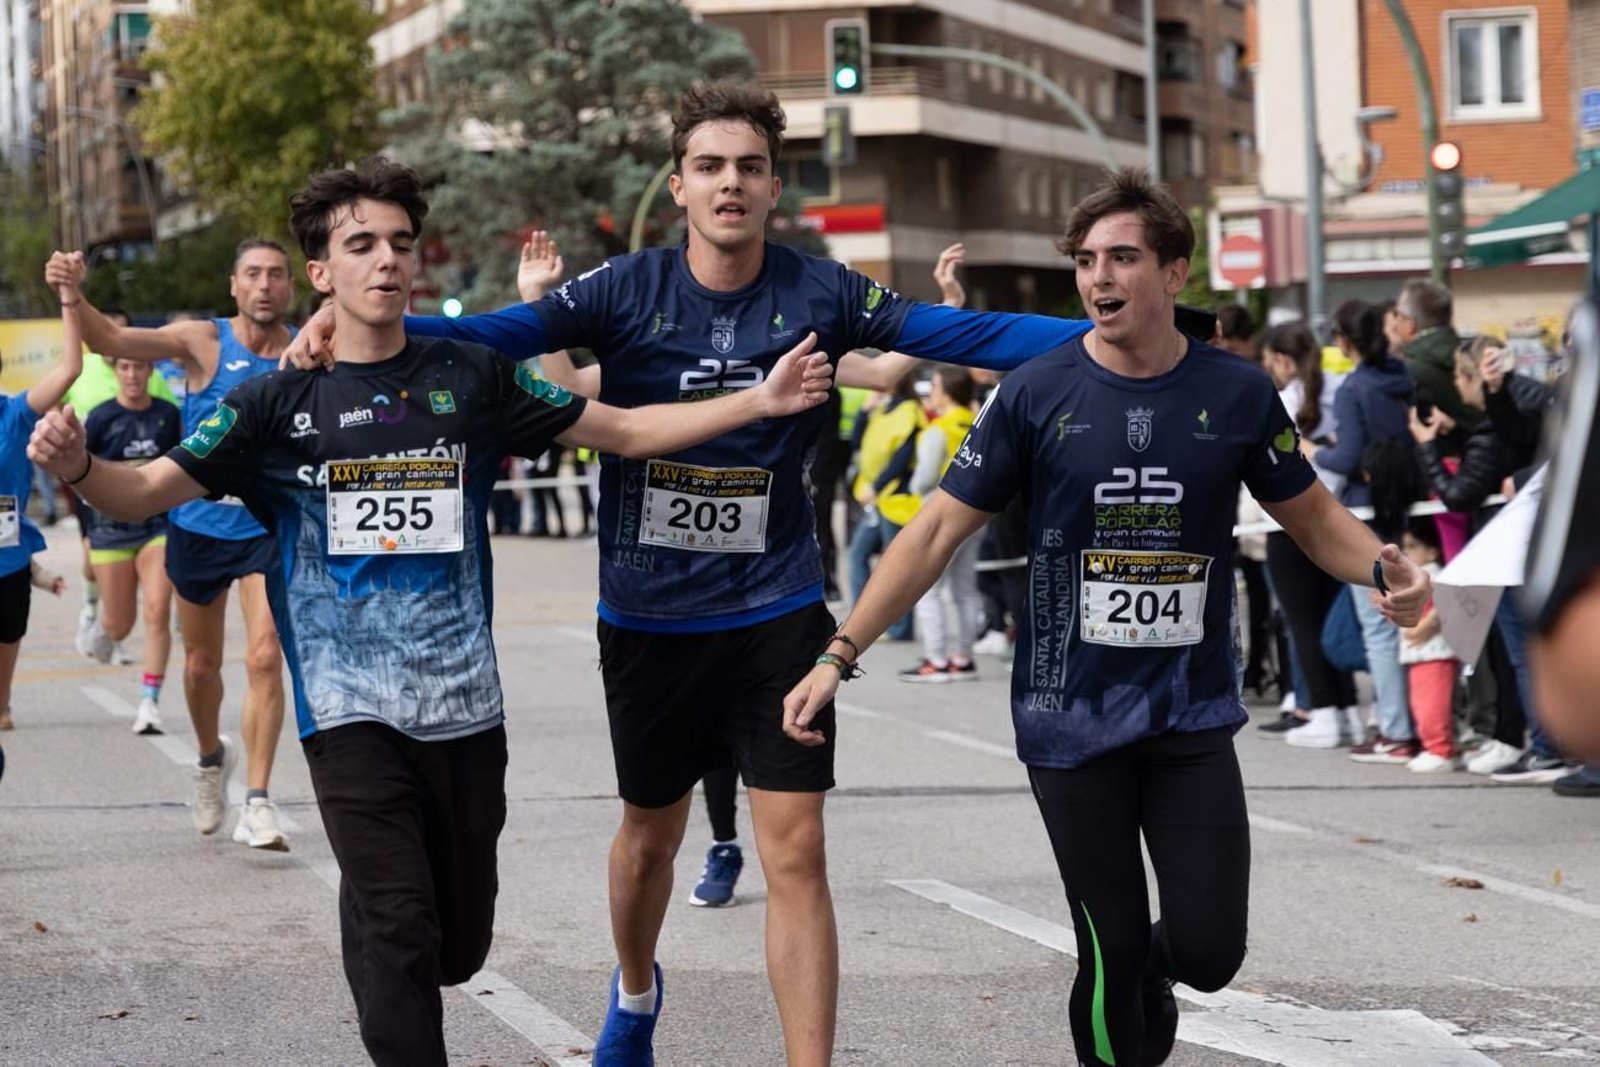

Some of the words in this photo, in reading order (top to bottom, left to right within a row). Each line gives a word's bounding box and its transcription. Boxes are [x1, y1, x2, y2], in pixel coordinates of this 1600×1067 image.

[679, 358, 764, 391] 25
[333, 465, 360, 481] XXV
[362, 464, 407, 472] CARRERA
[409, 463, 455, 471] POPULAR
[375, 472, 401, 480] gran
[406, 470, 455, 478] caminata
[652, 464, 679, 481] XXV
[681, 469, 723, 480] CARRERA
[692, 477, 716, 486] gran
[1094, 467, 1184, 504] 25
[356, 496, 433, 531] 255
[667, 498, 741, 533] 203
[1094, 505, 1181, 516] CARRERA
[1095, 517, 1182, 529] POPULAR
[1042, 529, 1063, 547] IES
[1088, 555, 1116, 571] XXV
[1117, 557, 1162, 565] CARRERA
[1130, 565, 1155, 573] gran
[1036, 553, 1050, 630] CATALINA
[1108, 589, 1182, 625] 204
[1036, 635, 1050, 687] SANTA
